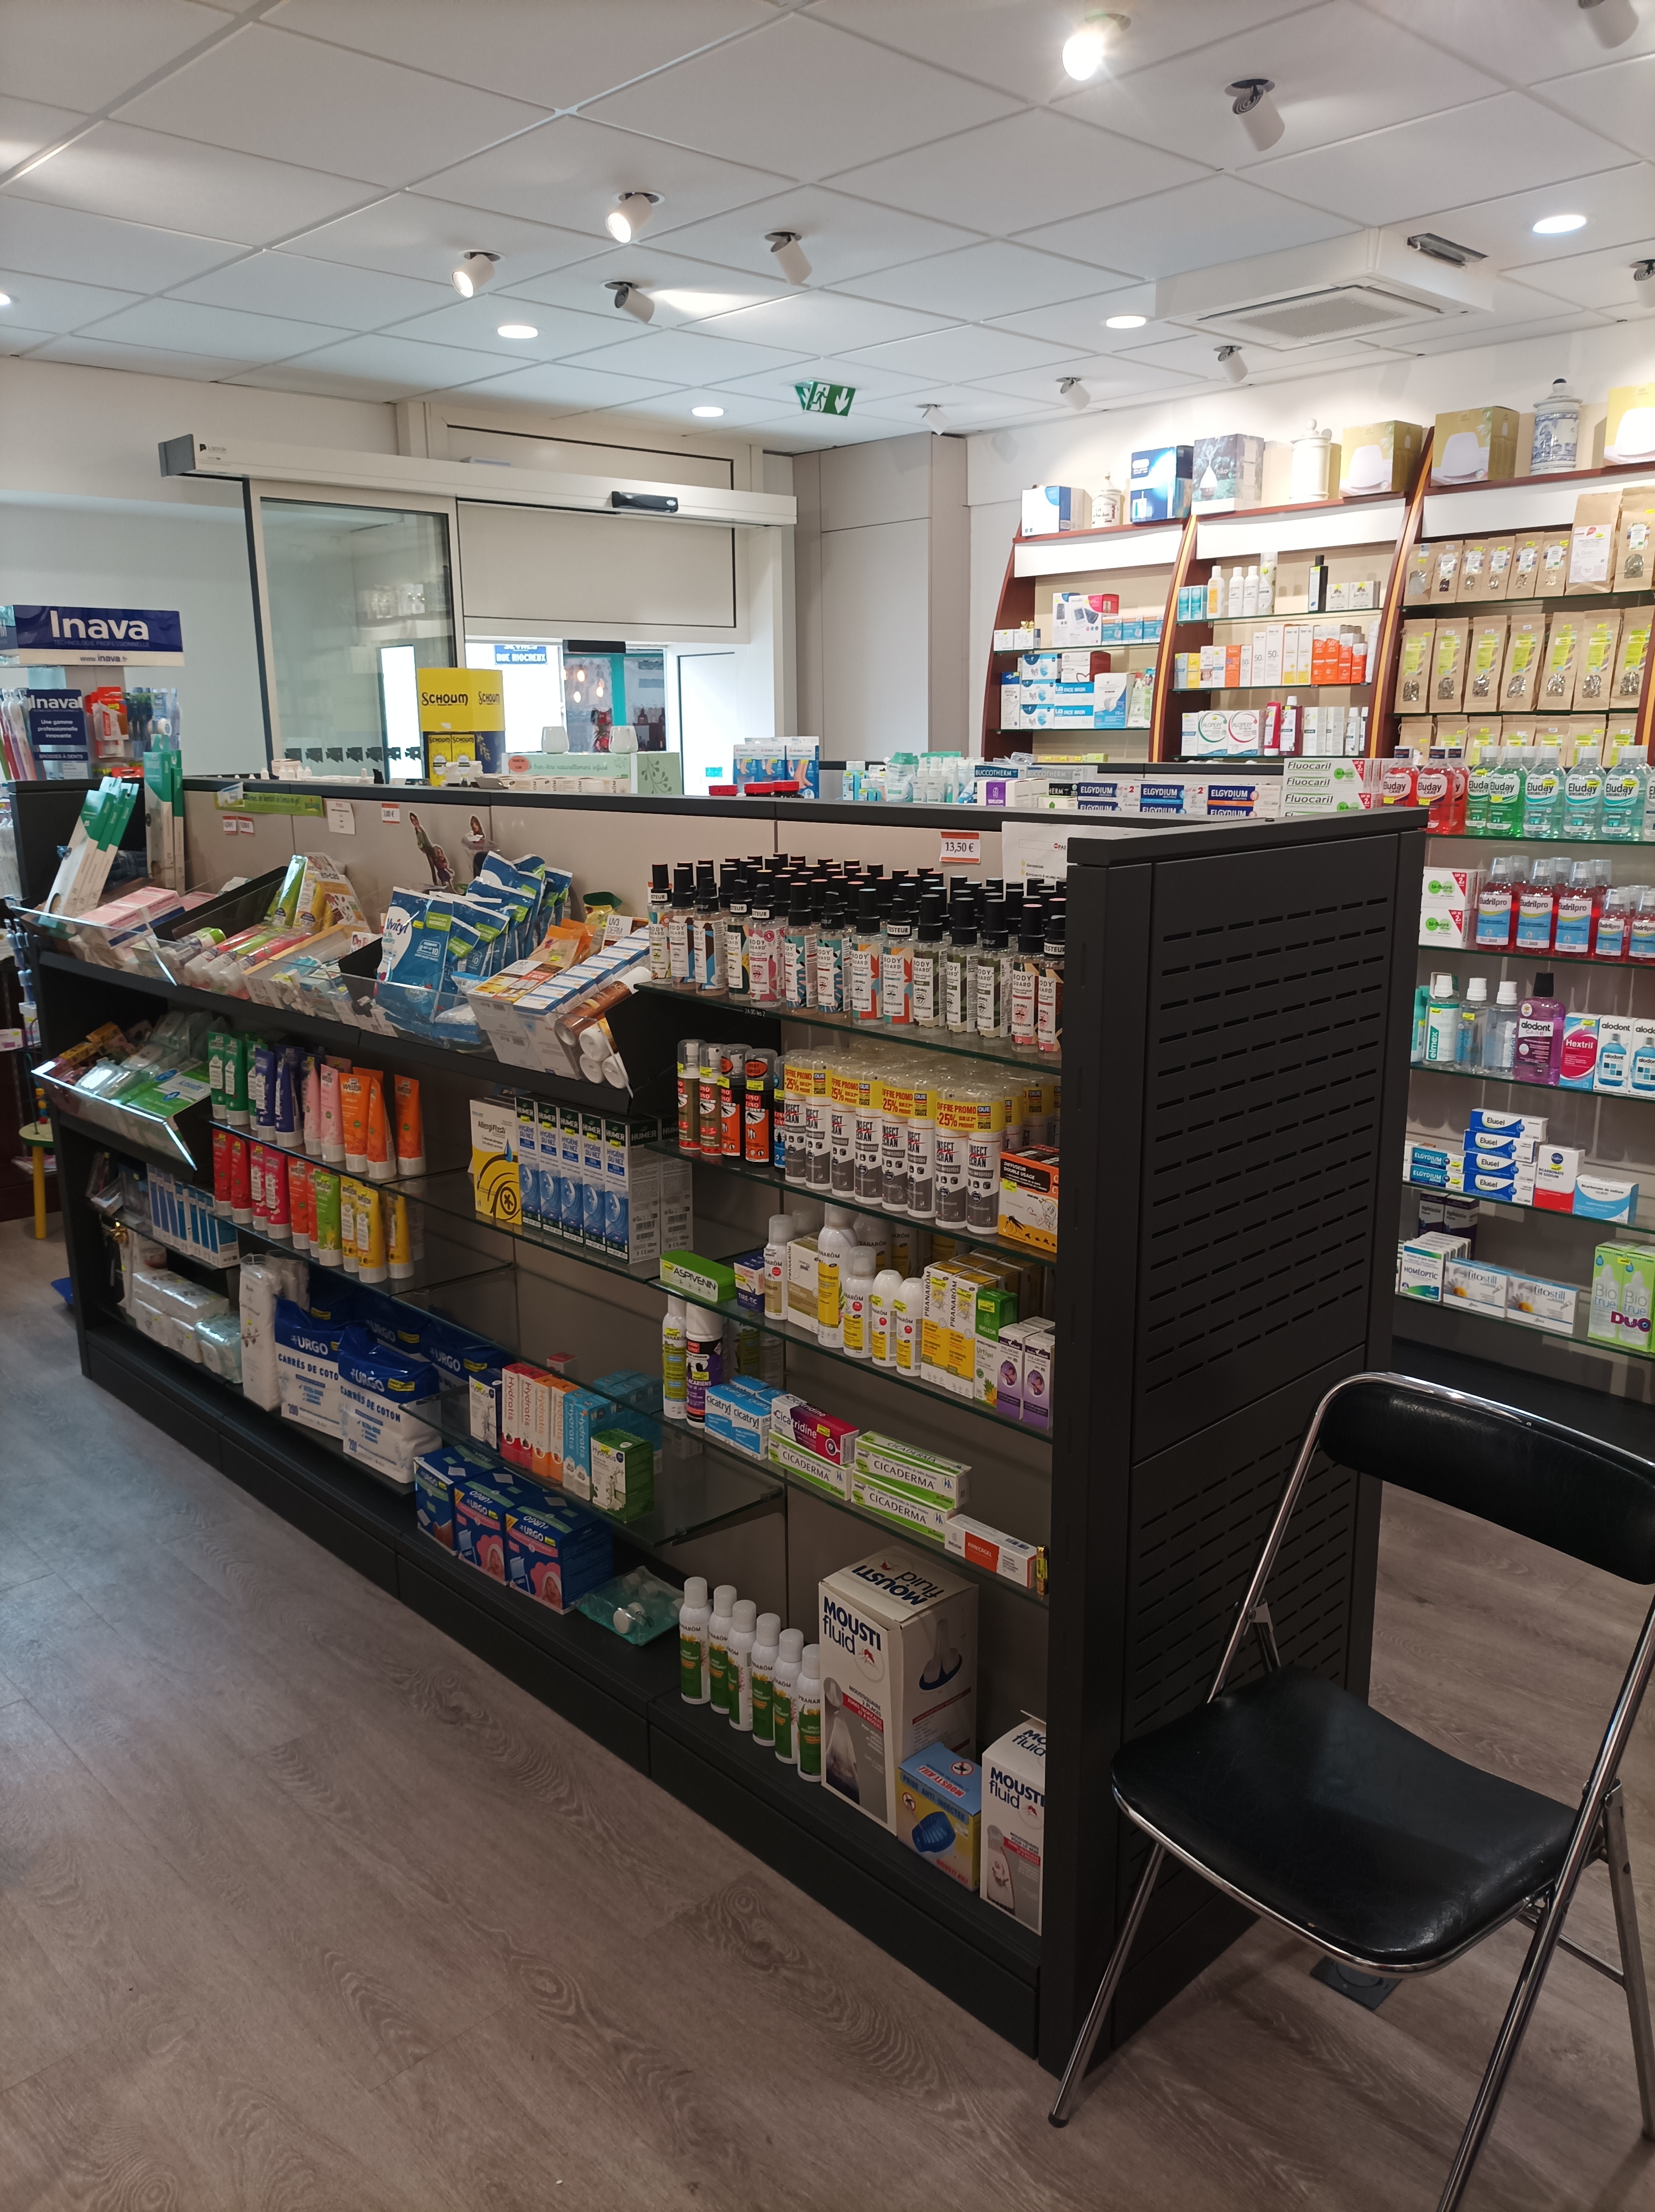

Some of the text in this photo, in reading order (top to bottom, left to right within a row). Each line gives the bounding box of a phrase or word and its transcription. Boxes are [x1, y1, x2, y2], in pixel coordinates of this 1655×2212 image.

[50, 611, 149, 640] Inava
[496, 654, 510, 662] RUE
[421, 692, 468, 706] SCHOUM
[1287, 761, 1331, 770] Fluocaril
[1027, 770, 1066, 778] BUCCOTHERM
[1287, 777, 1330, 786] Fluocaril
[1383, 781, 1406, 792] Eluday
[1418, 782, 1441, 792] Eluday
[1469, 780, 1489, 789] Eluda
[1490, 781, 1515, 792] Eluday
[1080, 786, 1113, 794] ELGYDIUM
[1143, 787, 1177, 796] ELGYDIUM
[1568, 783, 1597, 793] Eluday
[1211, 790, 1248, 799] ELGYDIUM
[1285, 794, 1334, 804] Fluocaril
[945, 842, 974, 853] 13,50 €
[608, 917, 620, 926] UV3
[607, 927, 623, 935] DERM
[1521, 1022, 1550, 1031] alodont
[1602, 1022, 1630, 1031] alodont
[1636, 1026, 1655, 1034] alodo
[1566, 1040, 1593, 1048] Hextril
[797, 1071, 812, 1080] PROMO
[785, 1078, 799, 1091] -25%
[517, 1107, 533, 1117] HUMER
[937, 1102, 976, 1114] OFFRE PROMO
[539, 1112, 556, 1123] HUMER
[937, 1113, 957, 1127] -25%
[1487, 1117, 1505, 1126] Elugel
[856, 1120, 873, 1130] INSECT
[606, 1129, 625, 1141] HUMER
[631, 1129, 657, 1140] HUMER
[1480, 1136, 1497, 1146] Elugel
[591, 1150, 600, 1159] NEZ
[607, 1148, 625, 1160] HYGIÈNE
[969, 1145, 988, 1156] INSECT
[615, 1157, 624, 1166] NEZ
[1414, 1152, 1442, 1163] ELGYDIUM
[1481, 1158, 1500, 1167] Elugel
[1004, 1161, 1026, 1172] DIFFUSEUR
[1004, 1167, 1019, 1175] DOUBLE
[1538, 1167, 1564, 1176] BICARBONATE
[1480, 1178, 1498, 1188] Elugel
[1404, 1266, 1438, 1280] HOMÉOPTIC
[1467, 1269, 1497, 1285] fitostill
[673, 1267, 716, 1291] ASPIVENIN
[1534, 1285, 1565, 1300] fitostill
[1596, 1284, 1617, 1300] Bio
[738, 1293, 757, 1305] TIRE-TIC
[1595, 1297, 1616, 1309] true
[1626, 1290, 1647, 1306] Bio
[1625, 1303, 1646, 1316] true
[979, 1325, 996, 1335] WELEDA
[297, 1335, 329, 1355] URGO
[278, 1353, 305, 1369] CARRÉS
[319, 1368, 339, 1380] COTO
[355, 1370, 385, 1392] URGO
[340, 1385, 364, 1404] CARRÉS
[367, 1399, 375, 1411] DE
[376, 1404, 401, 1422] COTON
[706, 1395, 731, 1415] cicatryl
[788, 1395, 826, 1417] Cicatridine
[733, 1408, 759, 1427] cicatryl
[775, 1410, 817, 1439] Cicatridine
[783, 1451, 830, 1482] CICADERMA
[874, 1460, 934, 1490] CICADERMA
[870, 1493, 926, 1524] CICADERMA
[524, 1525, 544, 1542] URGO
[948, 1540, 962, 1550] WELEDA
[967, 1542, 992, 1557] ARNICAGEL
[851, 1565, 929, 1605] MOUSTI
[894, 1571, 945, 1598] fluid
[824, 1596, 881, 1651] MOUSTI
[823, 1614, 855, 1655] fluid
[798, 1695, 820, 1704] PRANAR
[990, 1766, 1044, 1807] MOUSTI
[903, 1774, 965, 1822] PRISE ANTI-INSECTES
[989, 1779, 1020, 1809] fluid
